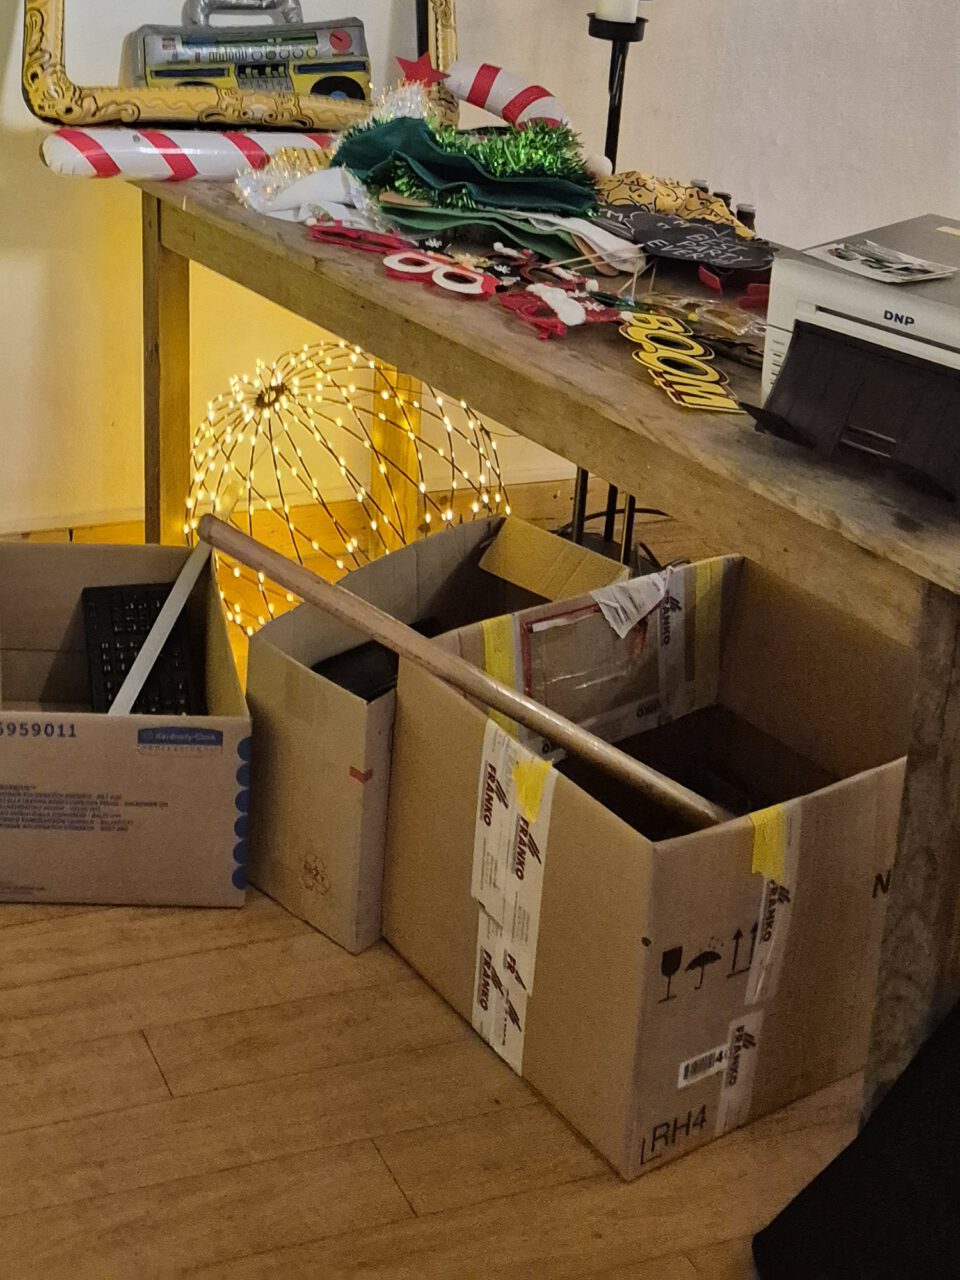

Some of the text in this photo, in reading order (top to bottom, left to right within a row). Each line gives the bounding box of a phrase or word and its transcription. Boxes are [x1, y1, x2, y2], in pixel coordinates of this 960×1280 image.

[883, 310, 916, 327] DNP
[619, 311, 747, 414] BOOM
[660, 590, 672, 646] RANKO
[483, 762, 497, 827] FRANKO
[515, 816, 530, 881] FRANKO
[479, 948, 493, 1012] FRANKO
